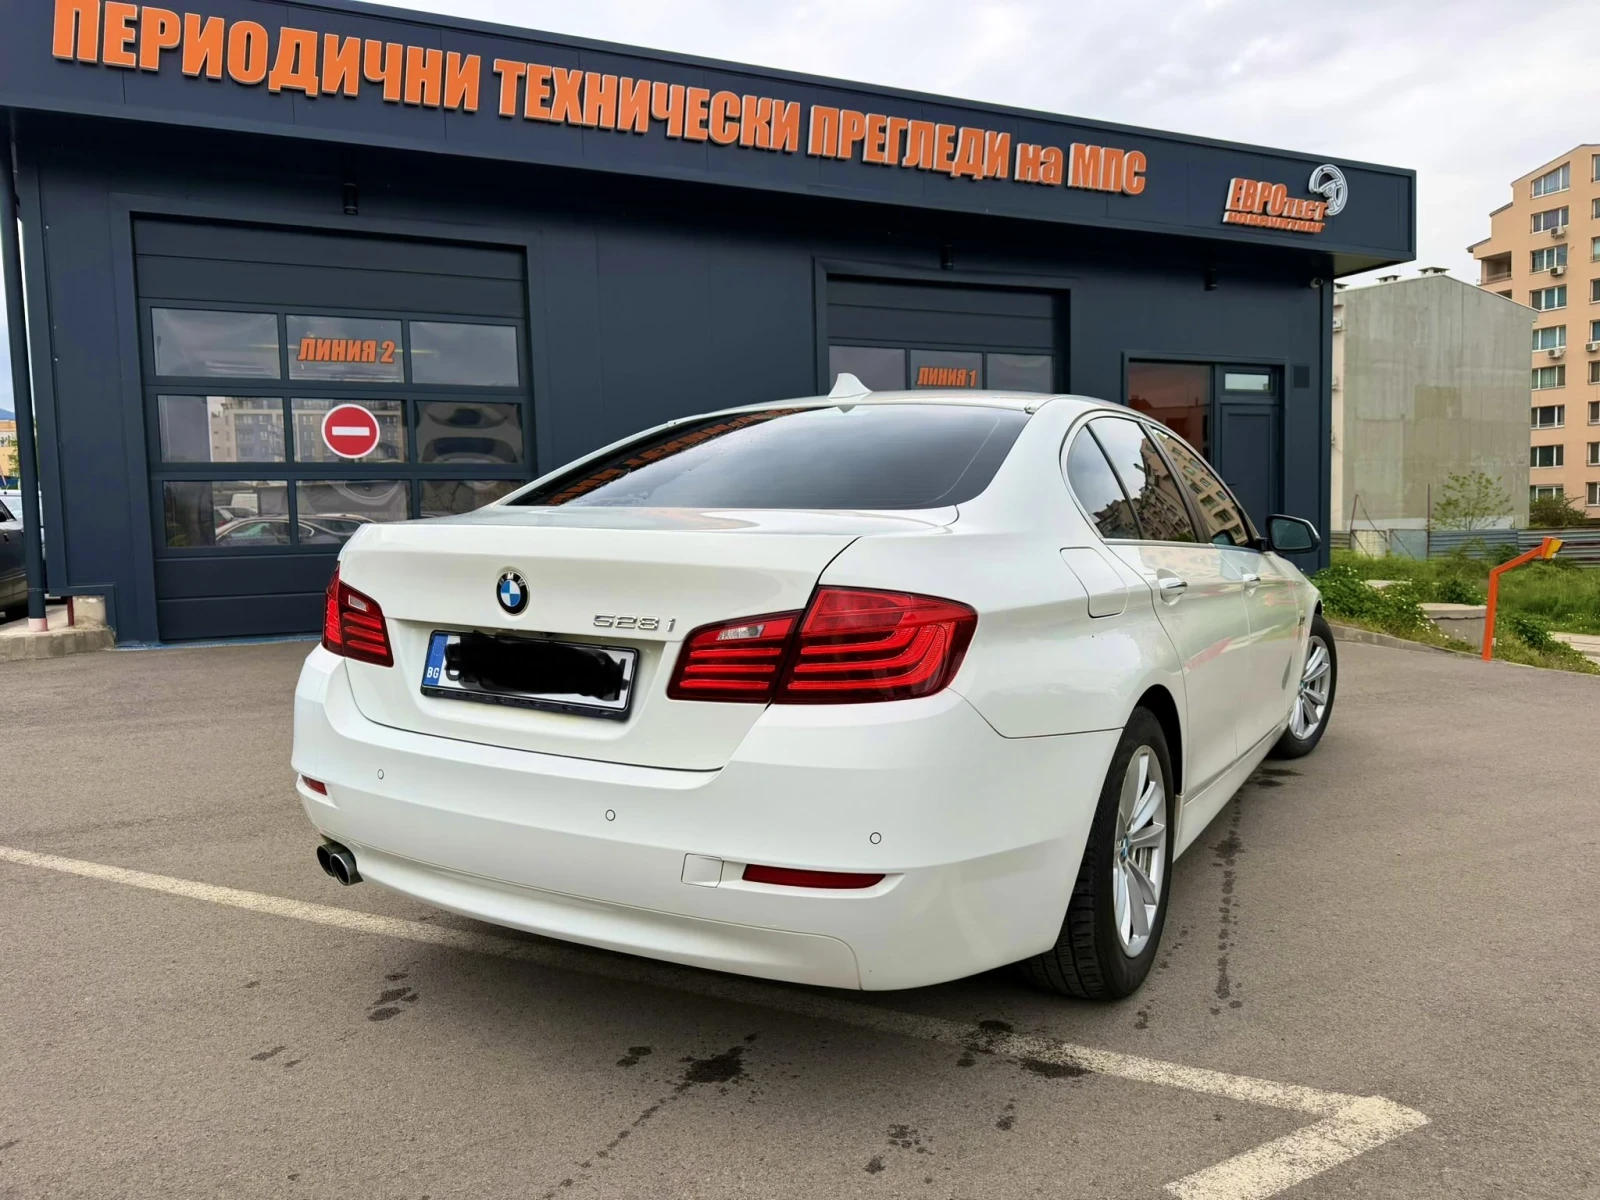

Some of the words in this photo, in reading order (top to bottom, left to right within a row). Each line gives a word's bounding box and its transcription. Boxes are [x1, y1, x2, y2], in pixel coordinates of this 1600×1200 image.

[52, 0, 480, 112] ПЕРИОДИЧНИ
[493, 58, 800, 152] ТЕХНИЧЕСКИ
[808, 104, 1011, 180] ПРЕГЛЕДИ
[1014, 143, 1063, 185] на
[1067, 142, 1146, 195] МПС
[298, 338, 377, 362] ЛИНИЯ
[380, 340, 396, 363] 2
[916, 366, 967, 387] ЛИНИЯ
[968, 369, 977, 388] 1
[426, 666, 440, 679] BG
